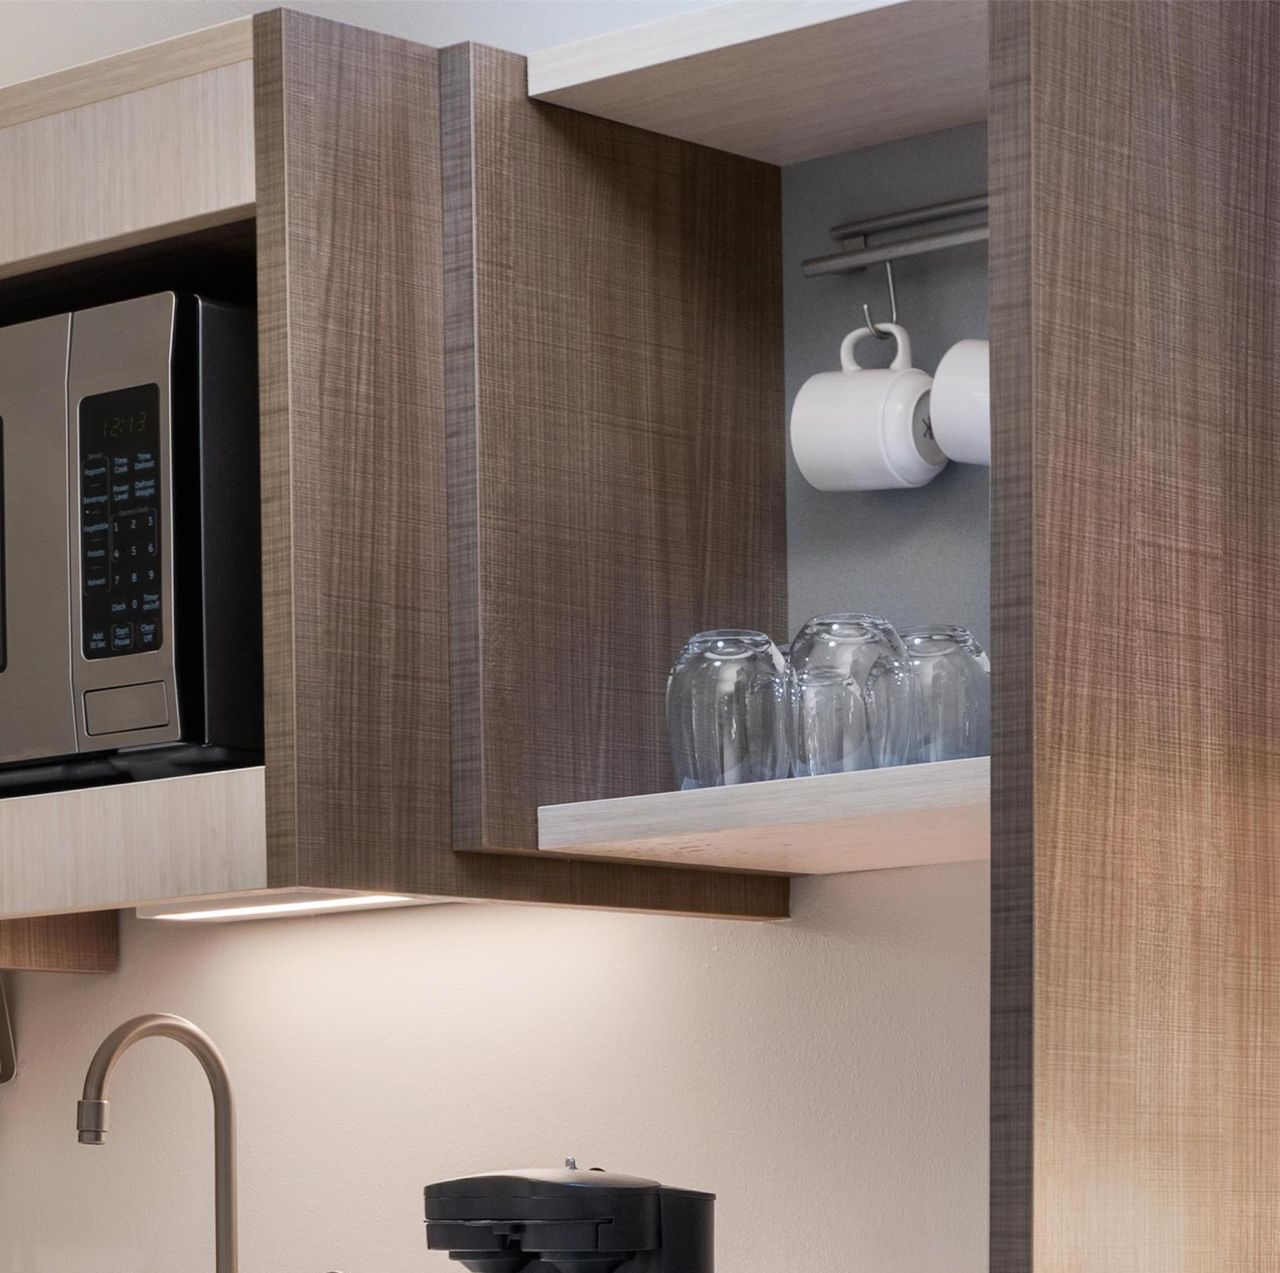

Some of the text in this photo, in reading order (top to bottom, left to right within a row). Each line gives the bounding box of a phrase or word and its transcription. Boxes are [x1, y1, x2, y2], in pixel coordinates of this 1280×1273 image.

[104, 411, 146, 438] 12:13
[114, 517, 153, 532] 1 2 3
[114, 543, 154, 559] 4 5 6
[114, 570, 154, 585] 7 8 9
[112, 602, 127, 611] Clock
